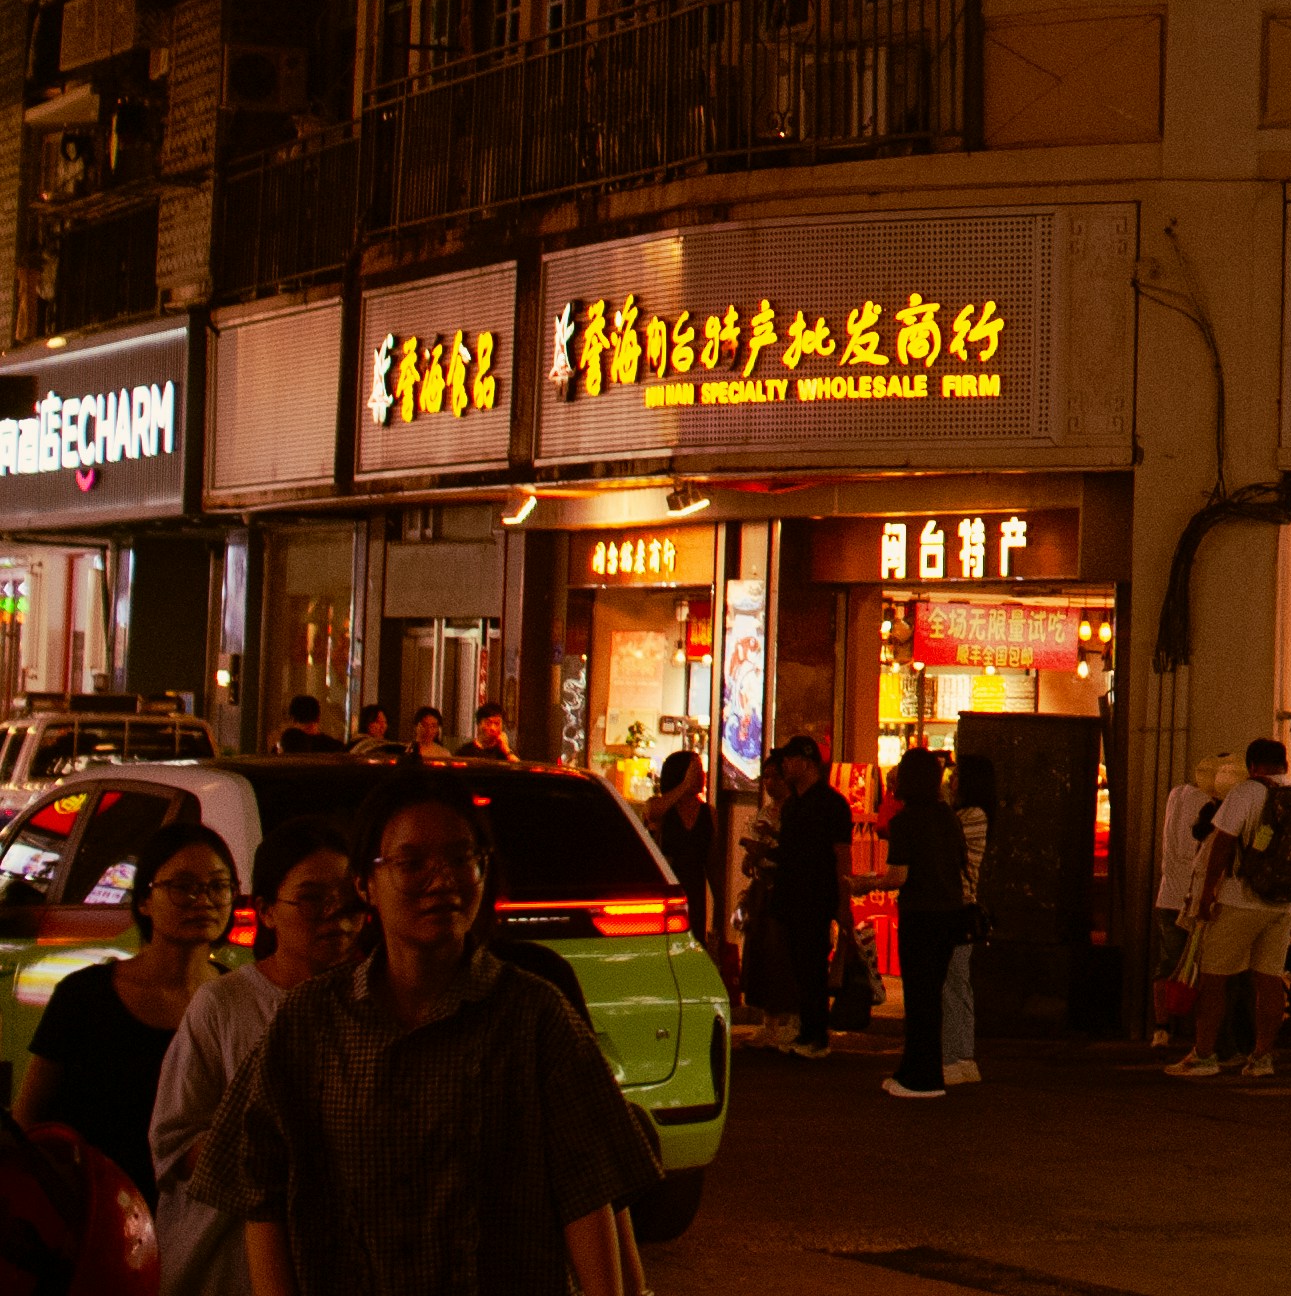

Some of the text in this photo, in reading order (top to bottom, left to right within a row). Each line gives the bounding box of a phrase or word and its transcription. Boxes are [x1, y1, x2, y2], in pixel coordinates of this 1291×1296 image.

[701, 378, 789, 404] SPECIALTY
[797, 374, 928, 401] WHOLESALE
[941, 373, 1001, 397] FIRM
[62, 380, 175, 470] ECHARM
[880, 516, 1028, 580] 闽台特产
[928, 606, 1068, 644] 全场无限量试吃
